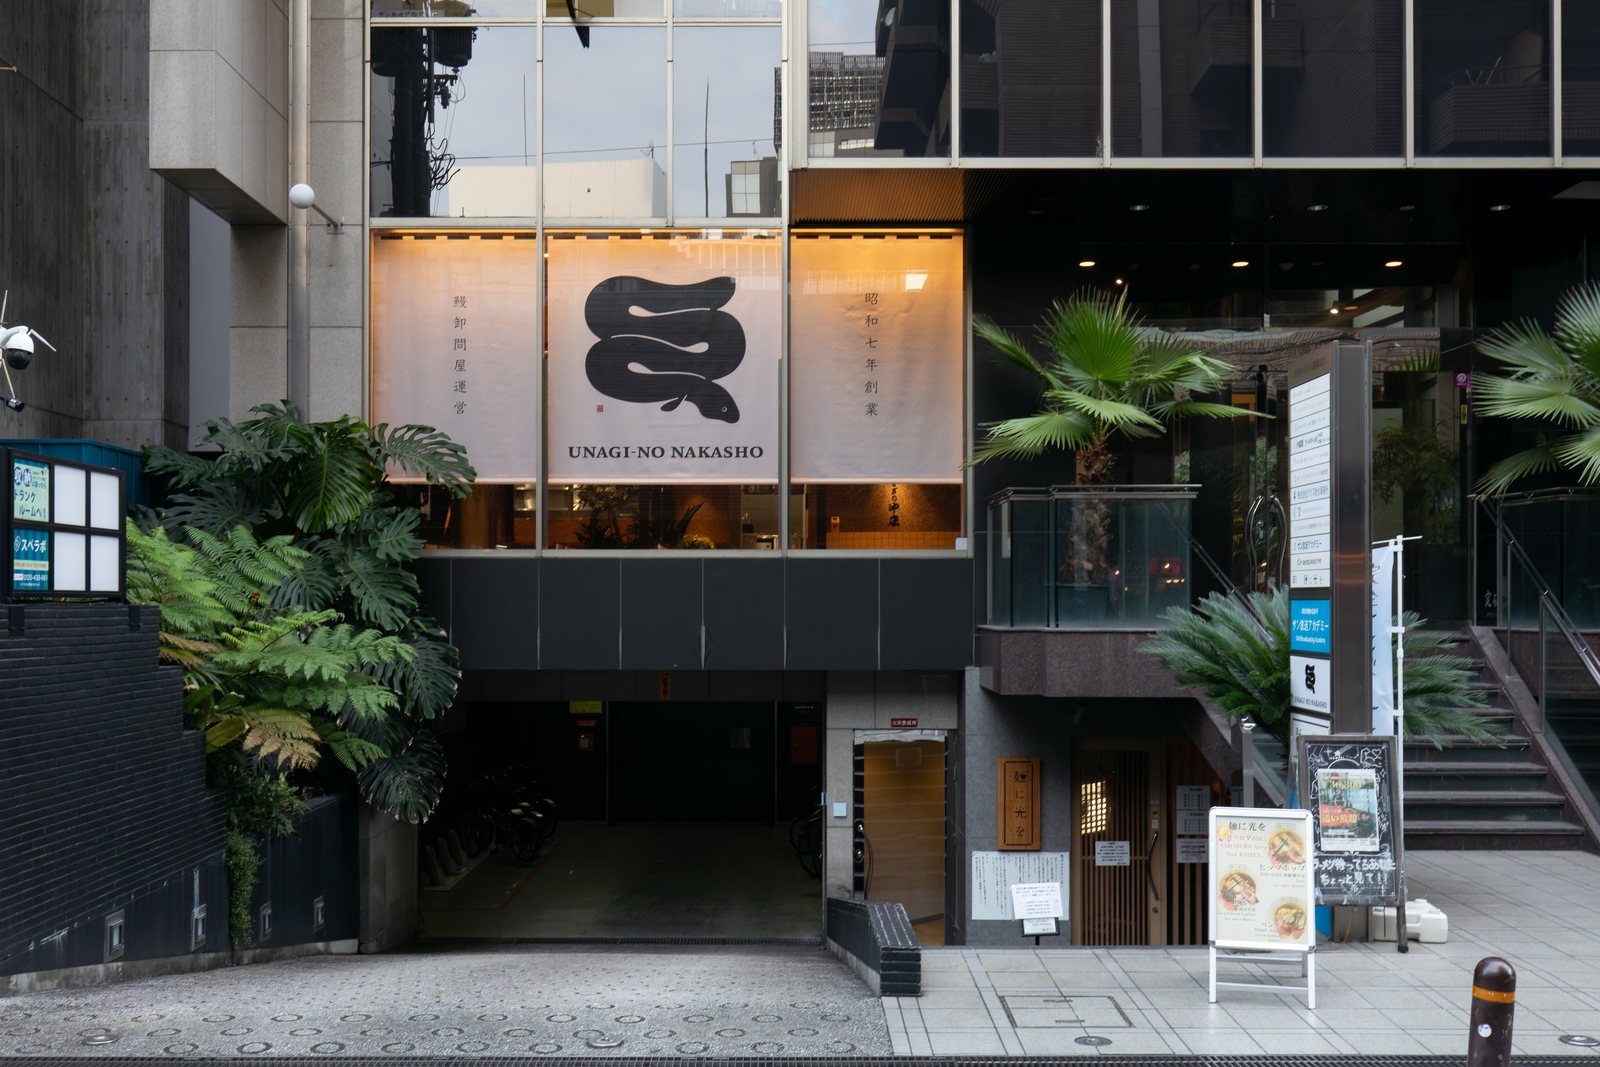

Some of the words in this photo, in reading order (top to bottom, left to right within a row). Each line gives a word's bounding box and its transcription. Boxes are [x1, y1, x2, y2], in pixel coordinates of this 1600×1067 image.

[453, 295, 468, 415] 鰻卸問屋運営
[864, 293, 878, 417] 昭和七年創業
[568, 446, 665, 459] UNAGI-NO
[670, 446, 764, 459] NAKASHO
[22, 539, 47, 553] スペラボ
[1291, 619, 1329, 632] サン放送アカデミー
[1014, 771, 1027, 836] 麺に光を
[1229, 821, 1267, 832] 麺に光を
